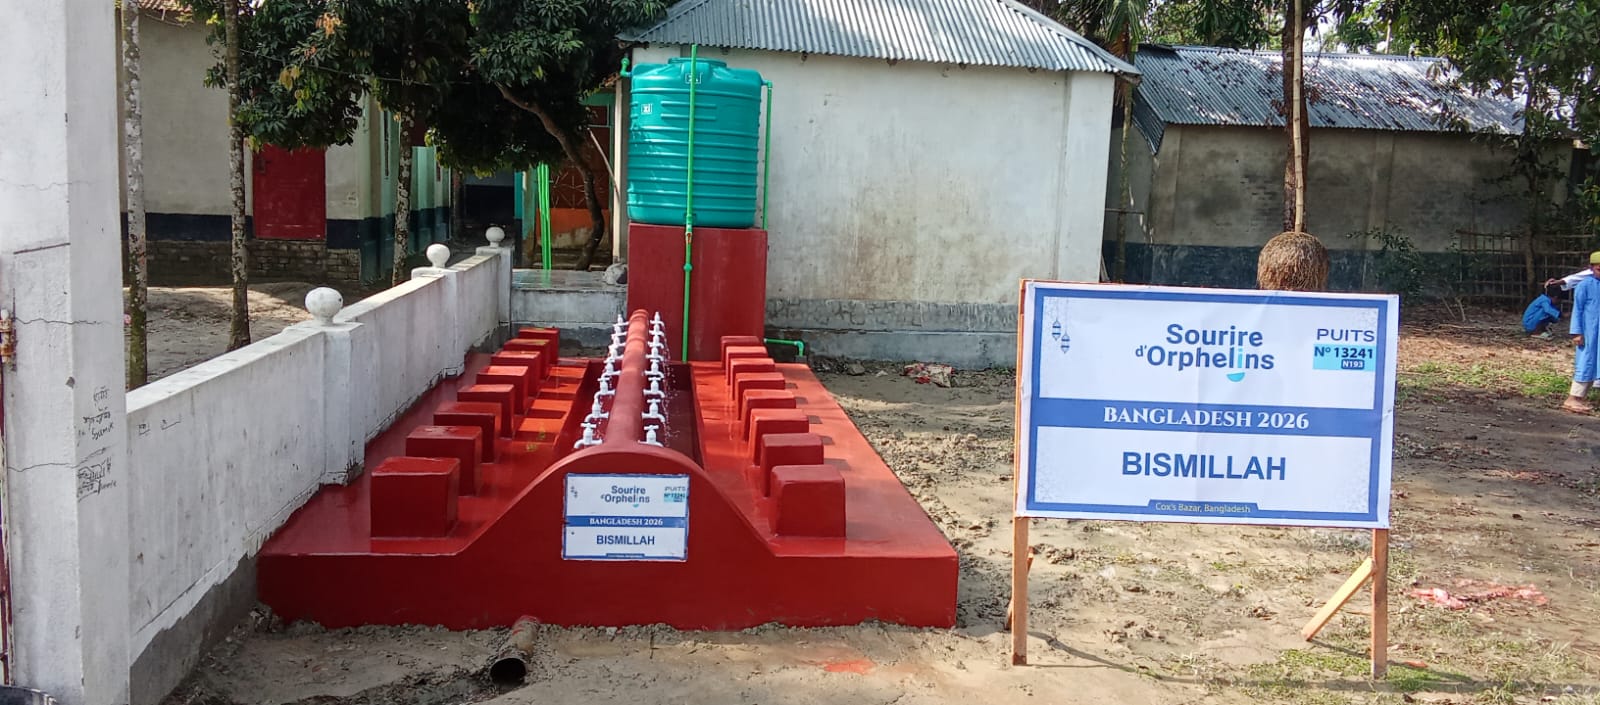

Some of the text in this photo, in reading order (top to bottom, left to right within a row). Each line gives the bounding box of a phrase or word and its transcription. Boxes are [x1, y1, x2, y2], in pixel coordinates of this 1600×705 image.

[1166, 323, 1263, 347] Sourire
[1316, 328, 1375, 342] PUITS
[1135, 345, 1275, 371] d'Orphelins
[1334, 347, 1373, 359] 13241
[1342, 359, 1364, 369] N193
[1103, 406, 1310, 430] BANGLADESH 2026
[1122, 451, 1286, 481] BISMILLAH
[611, 485, 646, 495] Sourire
[1155, 502, 1251, 515] Cox's Bazar, Bangladesh
[589, 517, 663, 526] BANGLADESH 2026
[596, 534, 655, 545] BISMILLAH
